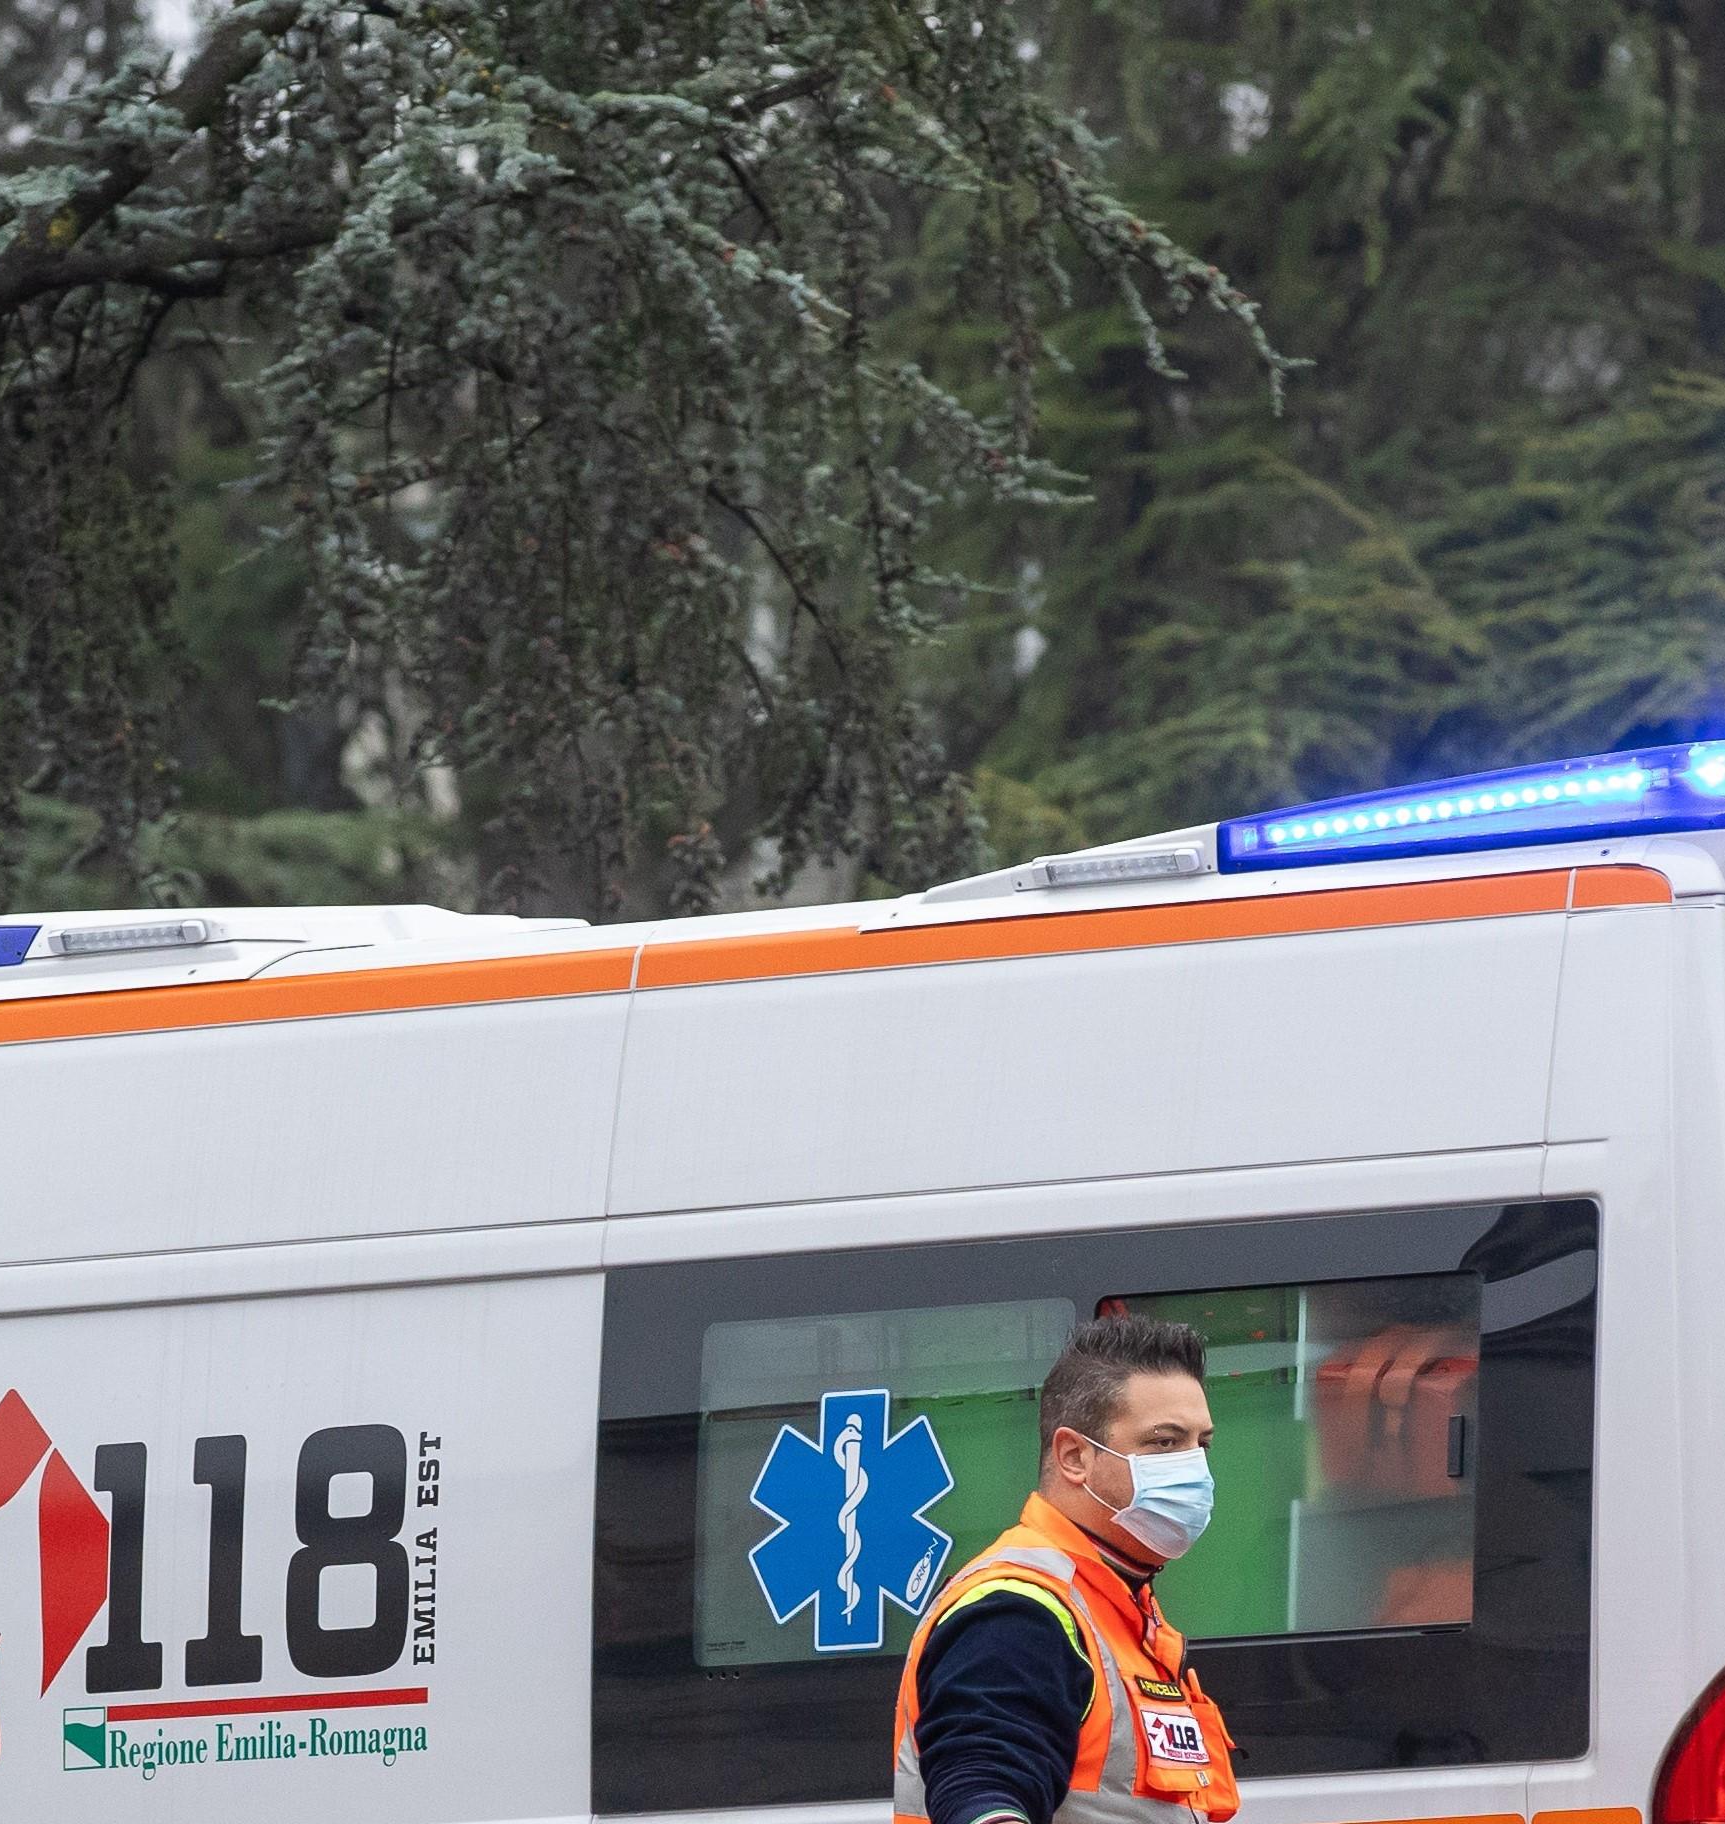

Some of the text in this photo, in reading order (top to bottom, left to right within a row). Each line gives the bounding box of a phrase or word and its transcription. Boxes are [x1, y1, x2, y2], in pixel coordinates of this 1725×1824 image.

[84, 1423, 411, 1695] 118
[412, 1430, 443, 1667] EMILIA EST
[107, 1716, 429, 1781] Regione Emilia-Romagna
[1168, 1723, 1200, 1752] 118
